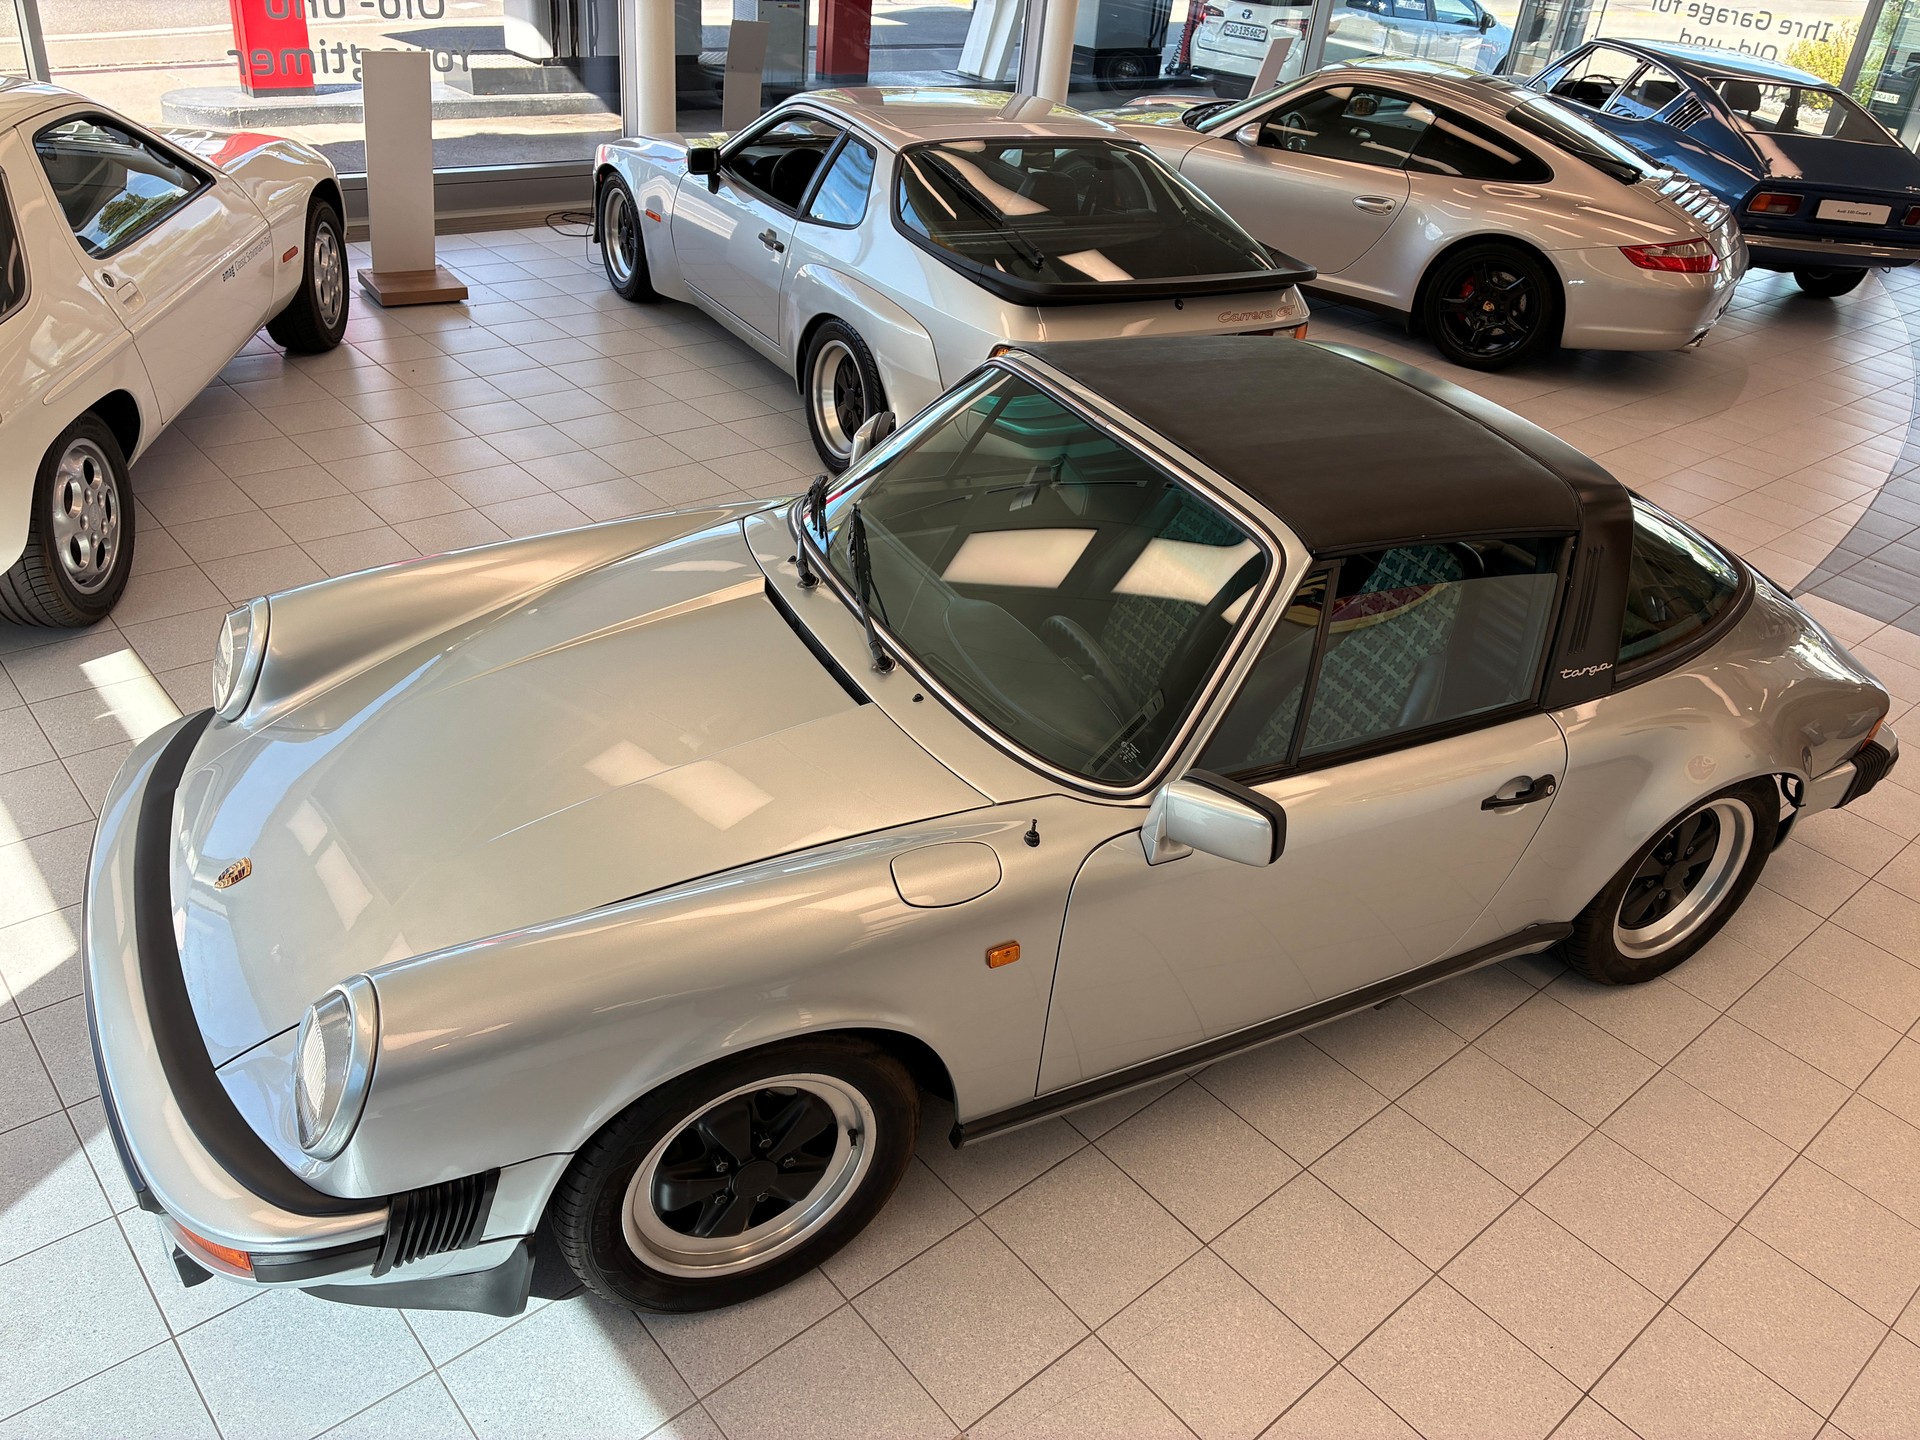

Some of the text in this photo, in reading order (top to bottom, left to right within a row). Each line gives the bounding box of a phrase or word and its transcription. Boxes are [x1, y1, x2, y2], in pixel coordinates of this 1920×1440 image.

[1217, 304, 1296, 324] Carrera GT
[1559, 661, 1614, 680] targa
